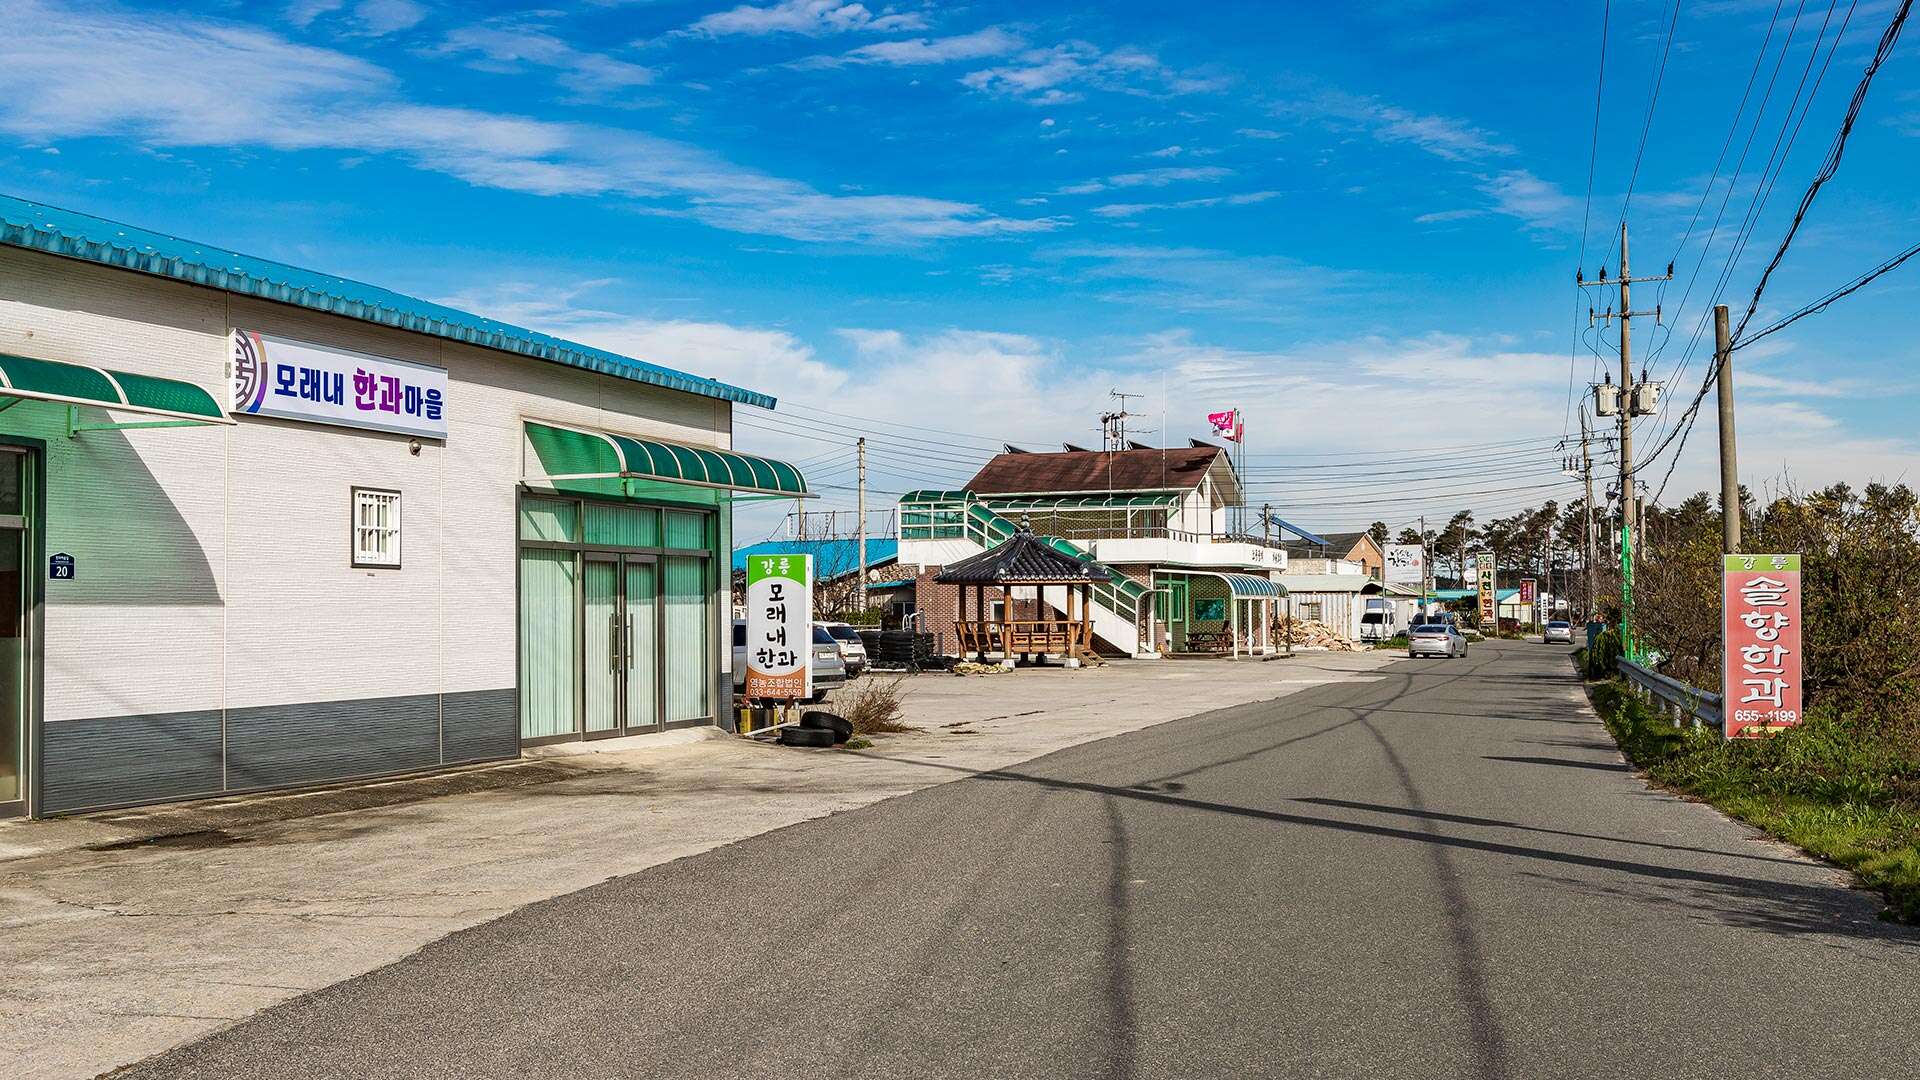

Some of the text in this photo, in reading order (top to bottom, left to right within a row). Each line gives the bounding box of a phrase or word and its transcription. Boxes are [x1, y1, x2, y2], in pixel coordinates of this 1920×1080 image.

[274, 363, 443, 420] 모래내 한과마을
[56, 566, 68, 577] 20
[761, 557, 791, 575] 강릉
[766, 584, 786, 647] 모래내
[1740, 576, 1790, 708] 솔향한과
[756, 648, 798, 669] 한과
[750, 678, 802, 689] 영농조합법인
[750, 688, 802, 697] 033-644-5559
